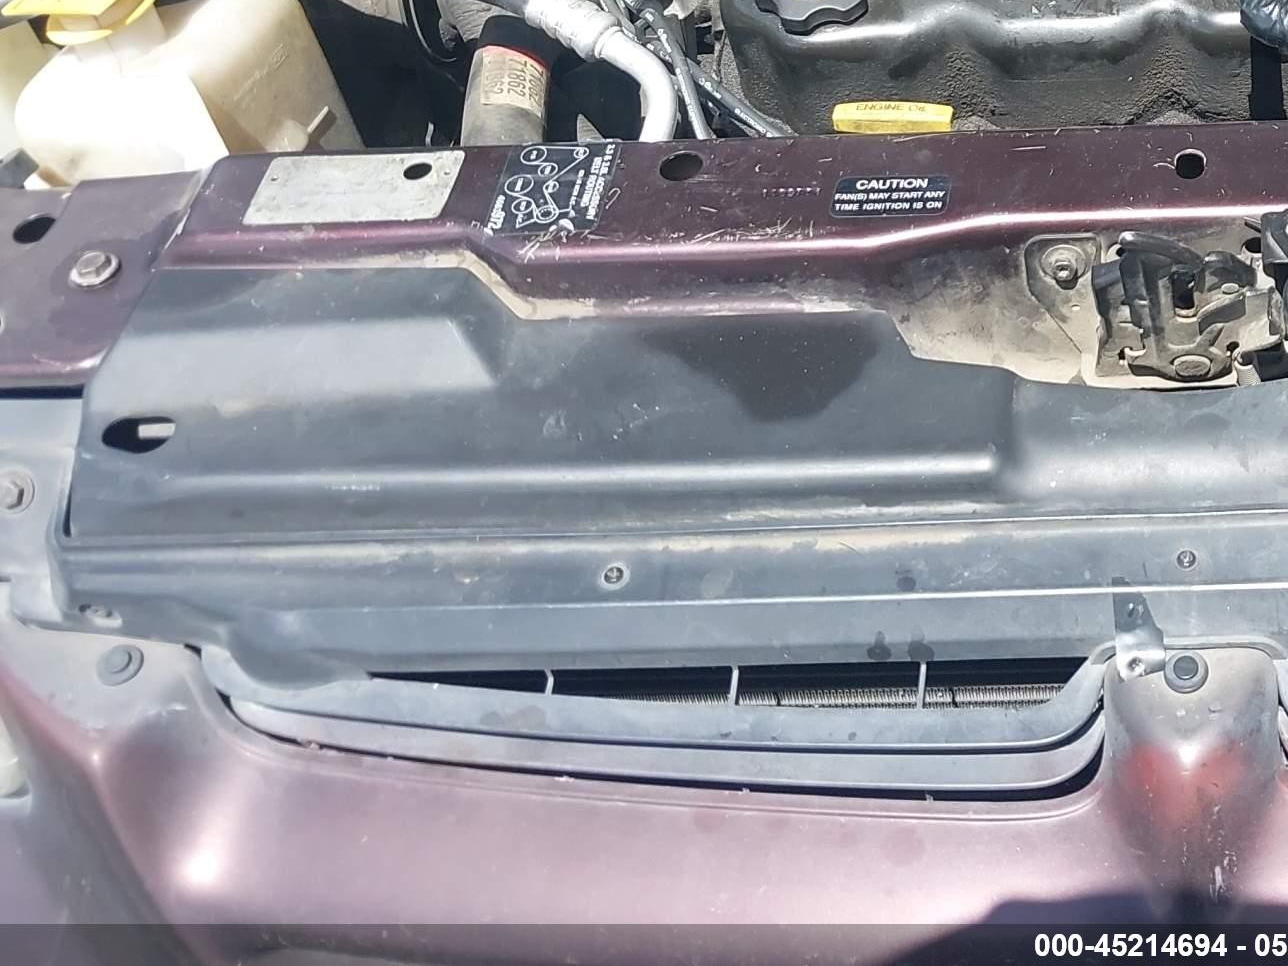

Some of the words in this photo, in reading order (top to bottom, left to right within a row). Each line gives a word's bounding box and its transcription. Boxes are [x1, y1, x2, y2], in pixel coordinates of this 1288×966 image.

[507, 58, 529, 98] 71862
[855, 103, 905, 111] ENGINE
[855, 178, 929, 190] CAUTION
[580, 174, 598, 207] ROUTING
[834, 192, 868, 201] FAN(S)
[868, 192, 891, 200] MAY
[891, 191, 924, 199] START
[923, 190, 946, 198] ANY
[834, 203, 860, 211] TIME
[862, 202, 910, 211] IGNITION
[912, 201, 924, 209] IS
[926, 201, 943, 209] ON
